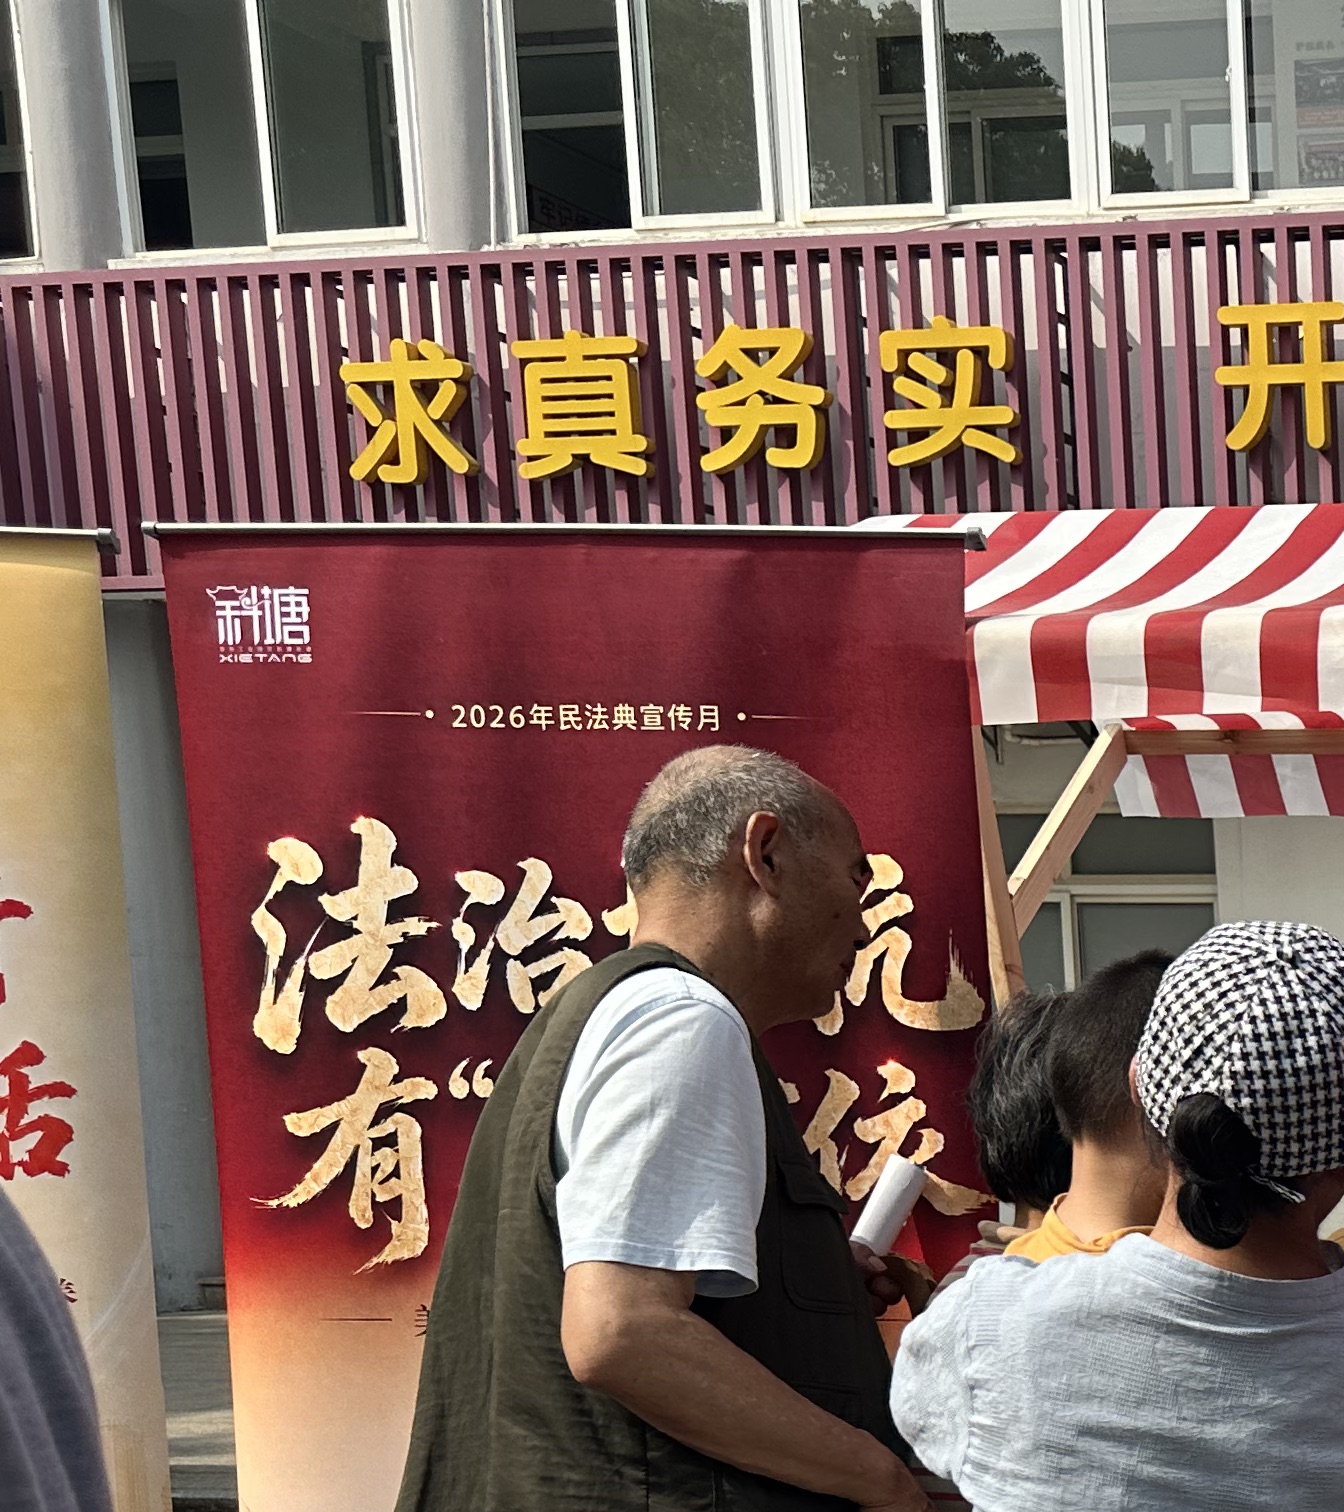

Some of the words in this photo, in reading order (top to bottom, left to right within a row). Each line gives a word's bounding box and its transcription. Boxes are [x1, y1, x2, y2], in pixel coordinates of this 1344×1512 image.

[340, 316, 1023, 485] 求真务实
[206, 586, 310, 646] 斜塘
[451, 703, 721, 732] 2026年民法典宣传月
